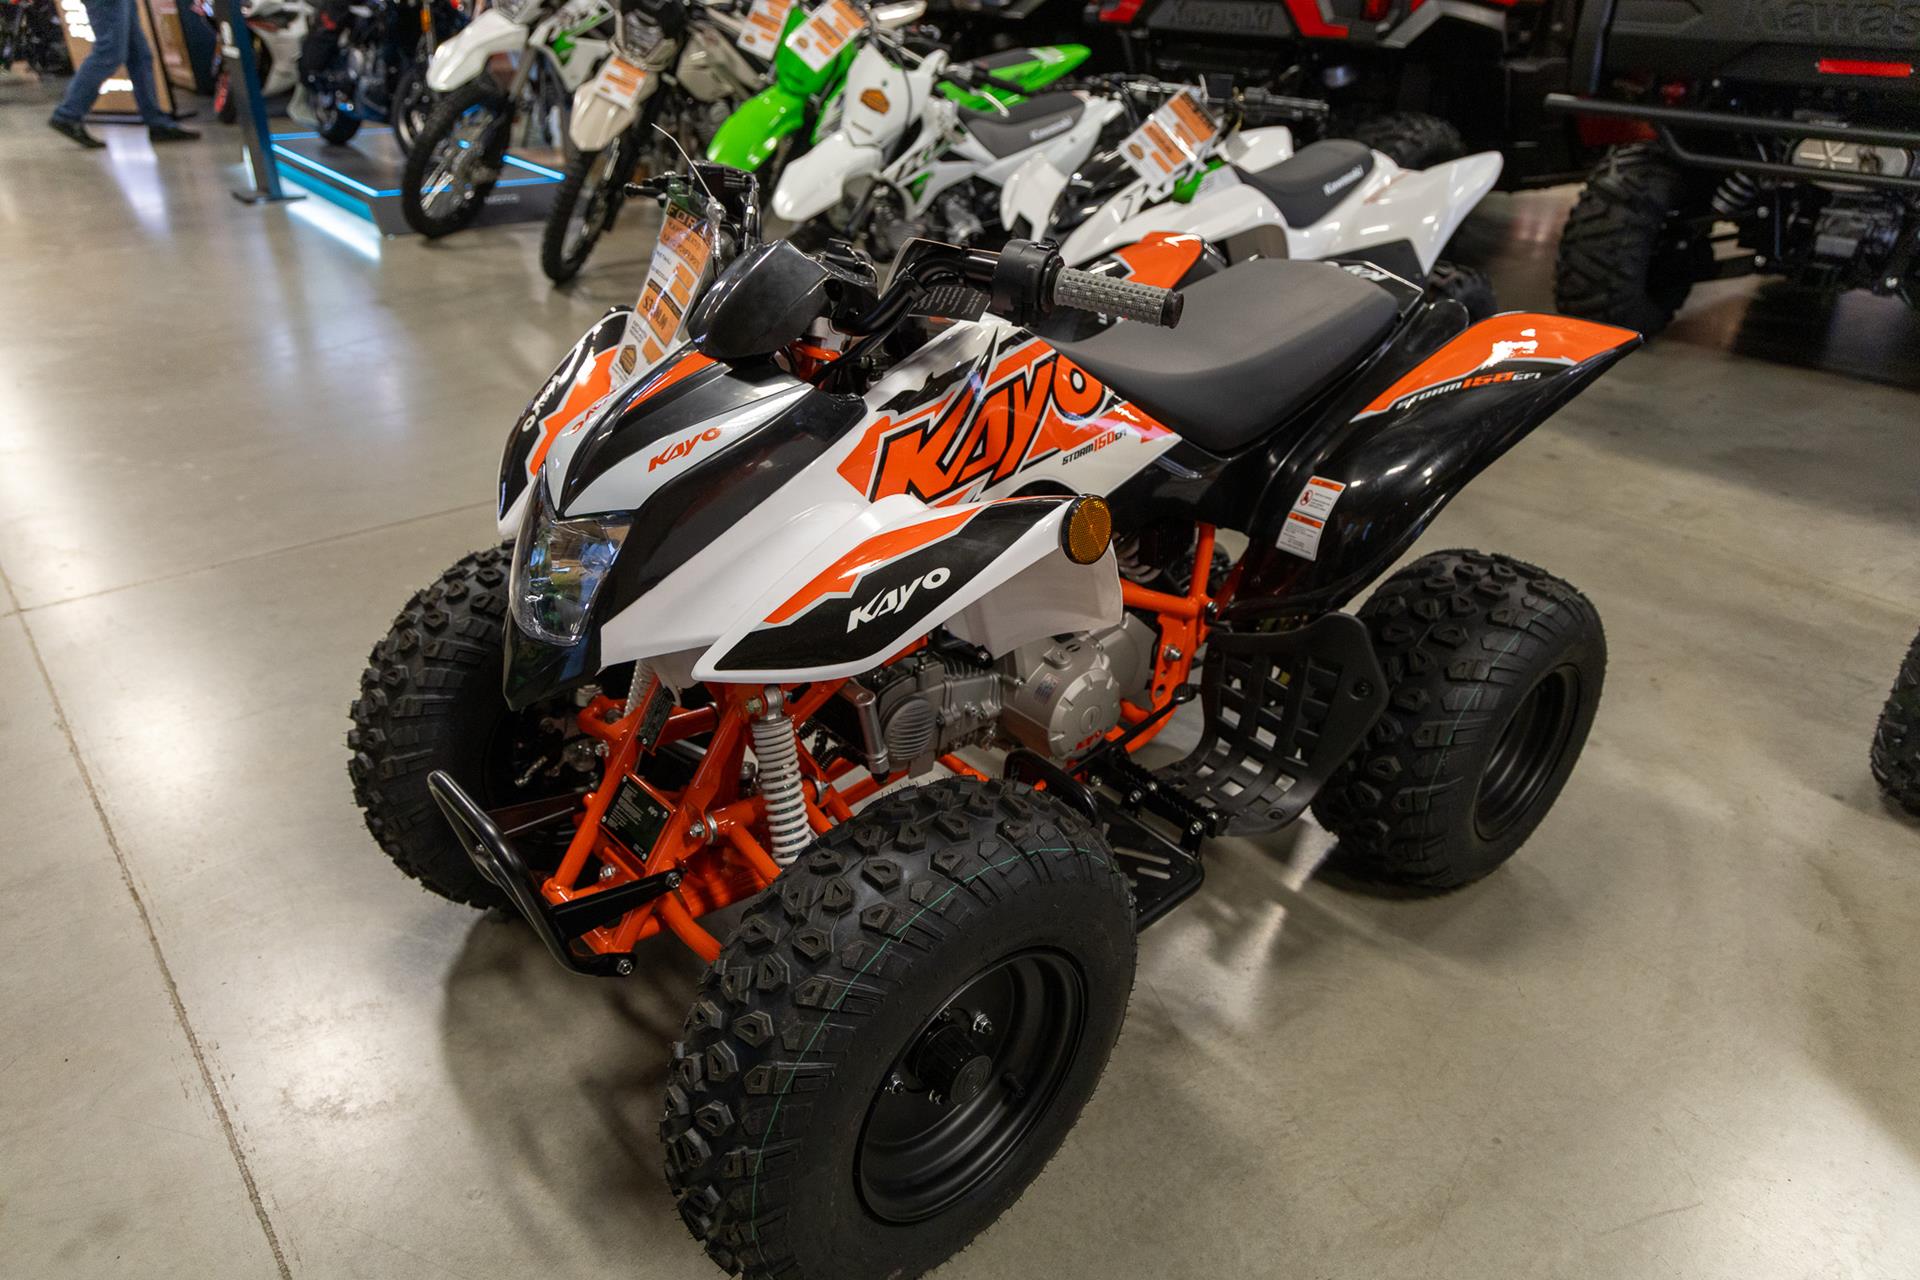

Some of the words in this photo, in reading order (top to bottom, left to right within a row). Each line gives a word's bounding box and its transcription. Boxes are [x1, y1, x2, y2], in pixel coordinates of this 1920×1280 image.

[648, 427, 721, 472] KAYO
[870, 352, 1104, 503] KAYO
[846, 567, 951, 634] KAYO
